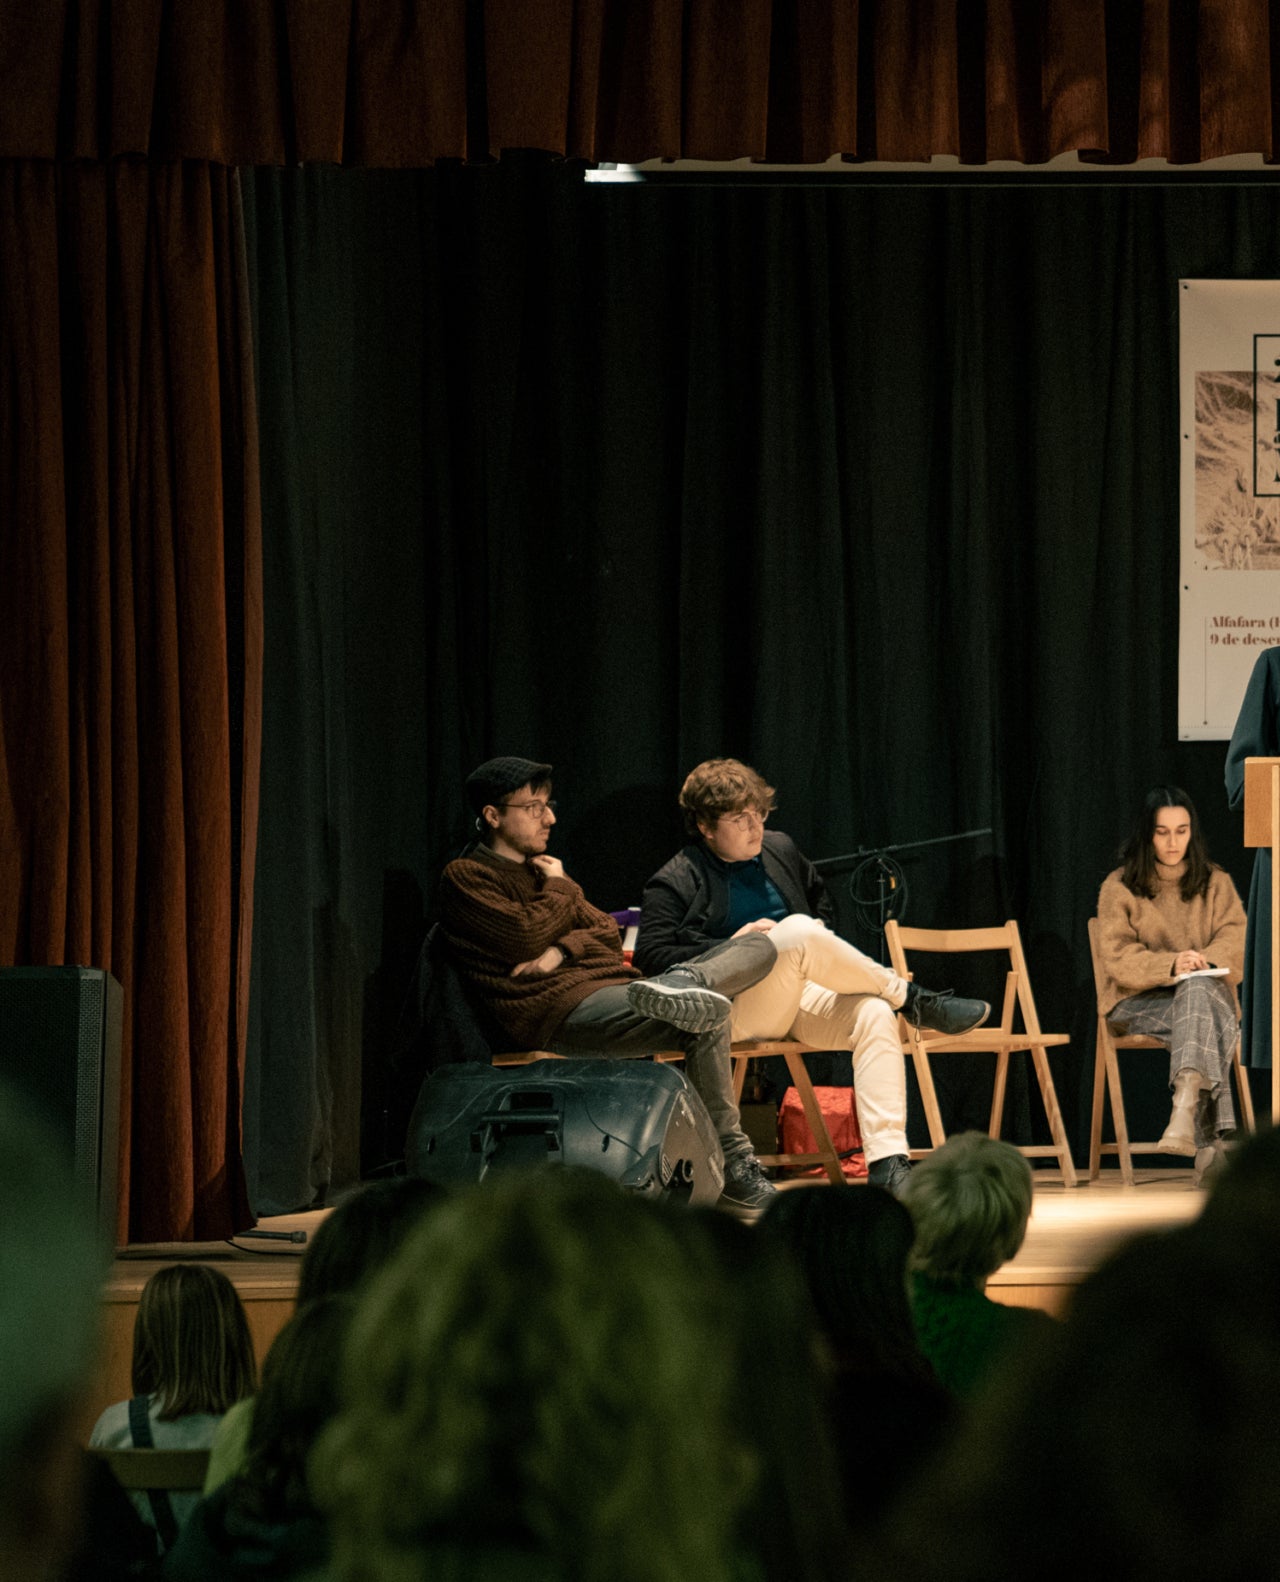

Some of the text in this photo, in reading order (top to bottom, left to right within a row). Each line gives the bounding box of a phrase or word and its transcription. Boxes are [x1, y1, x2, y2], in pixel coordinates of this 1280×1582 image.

[1210, 616, 1266, 628] Alfafara
[1210, 633, 1219, 645] 9
[1222, 633, 1239, 645] de
